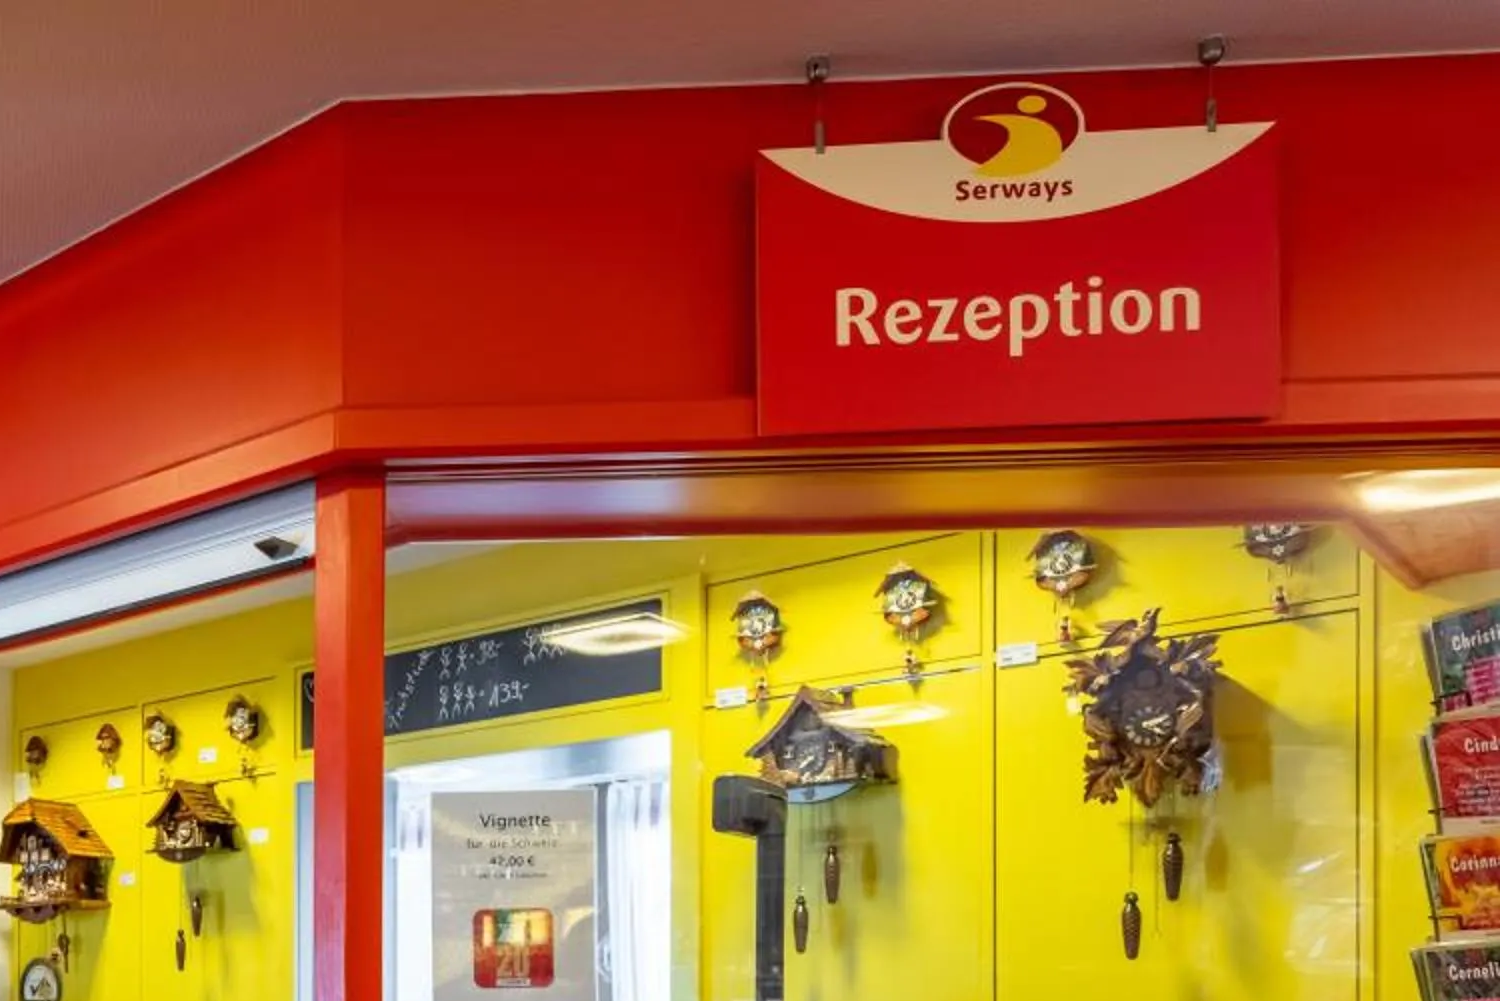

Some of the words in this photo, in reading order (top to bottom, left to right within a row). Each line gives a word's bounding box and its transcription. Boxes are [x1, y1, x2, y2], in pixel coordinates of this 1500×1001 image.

[955, 177, 1073, 202] Serways
[835, 277, 1201, 357] Rezeption
[479, 813, 551, 830] Vignette
[1451, 854, 1500, 873] Corinn
